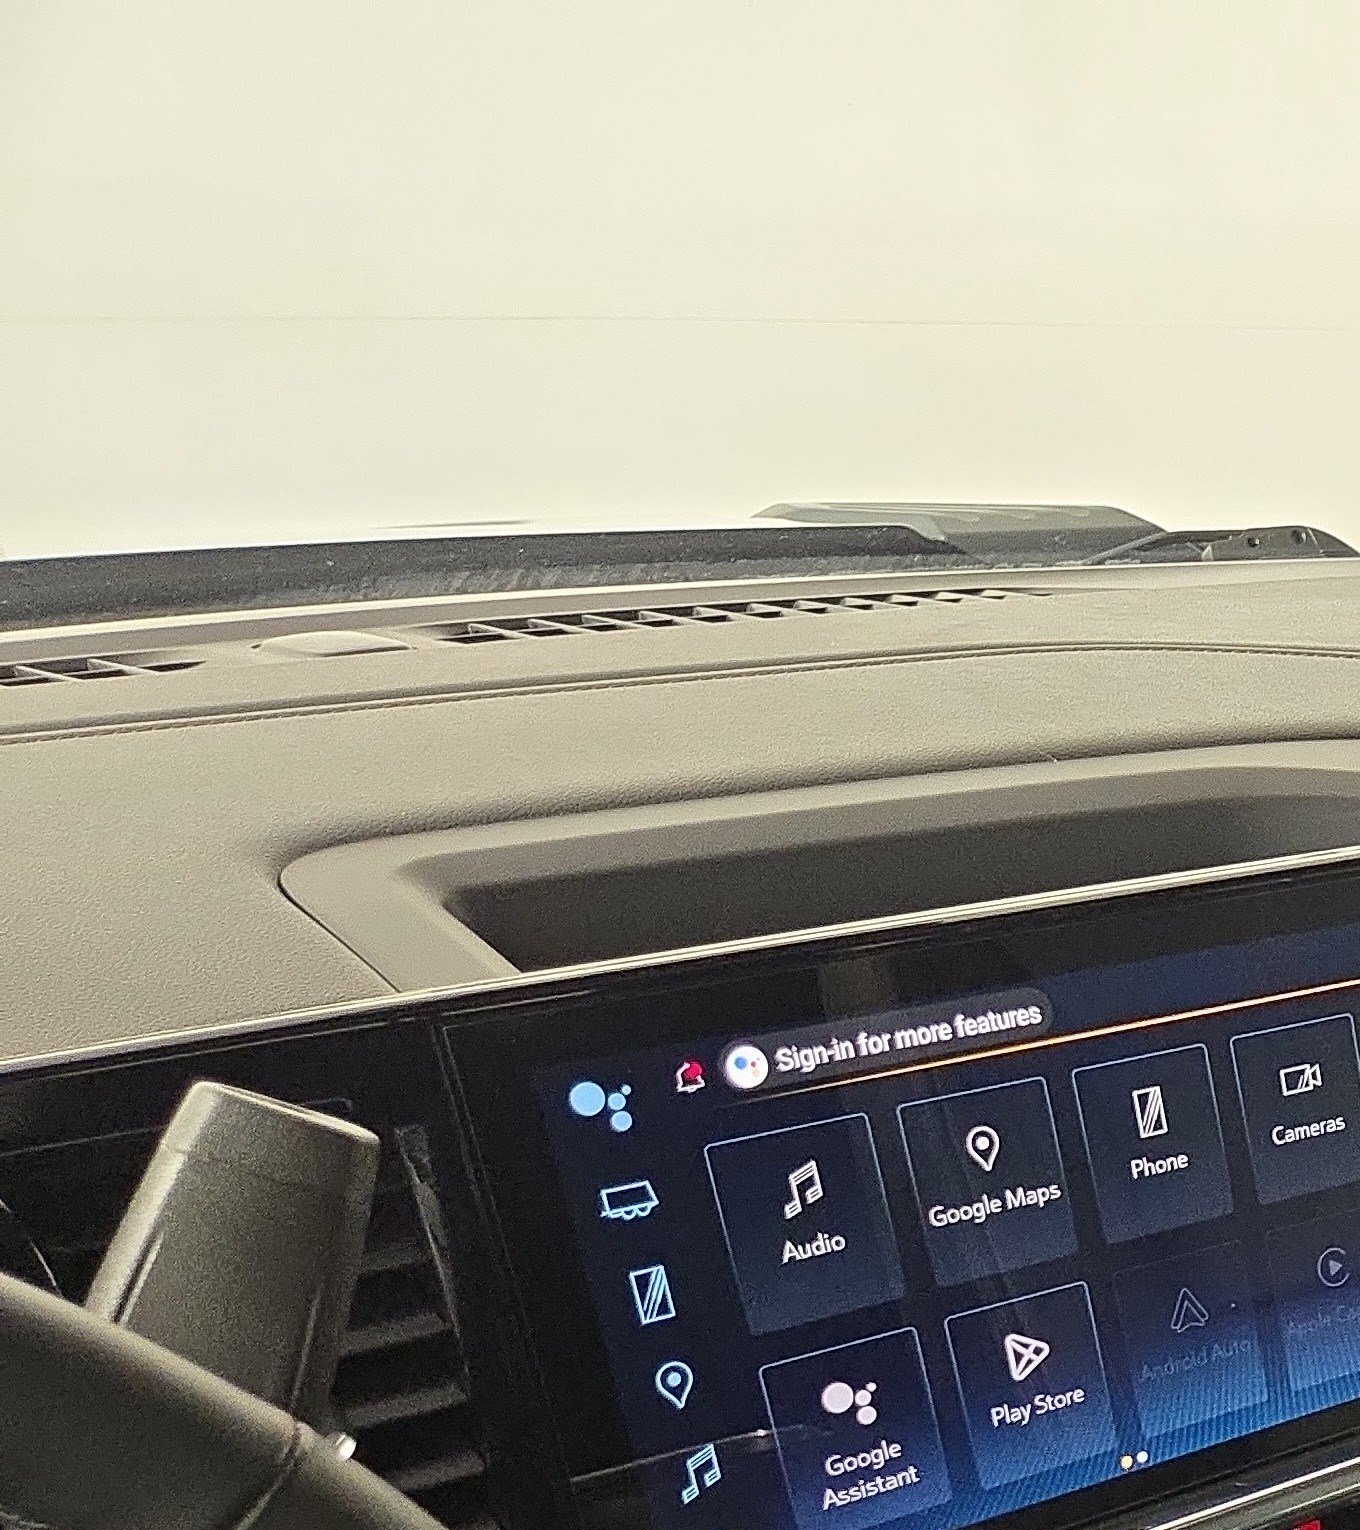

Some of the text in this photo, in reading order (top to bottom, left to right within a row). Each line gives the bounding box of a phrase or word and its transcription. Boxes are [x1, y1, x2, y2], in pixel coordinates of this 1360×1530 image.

[774, 1004, 1043, 1073] Sign-in for more features
[1271, 1116, 1346, 1146] Cameras
[1130, 1154, 1189, 1180] Phone
[929, 1181, 1062, 1228] Google Maps
[782, 1231, 846, 1264] Audio
[991, 1386, 1086, 1428] Play Store
[824, 1440, 902, 1478] Google
[822, 1465, 920, 1511] Assistant
